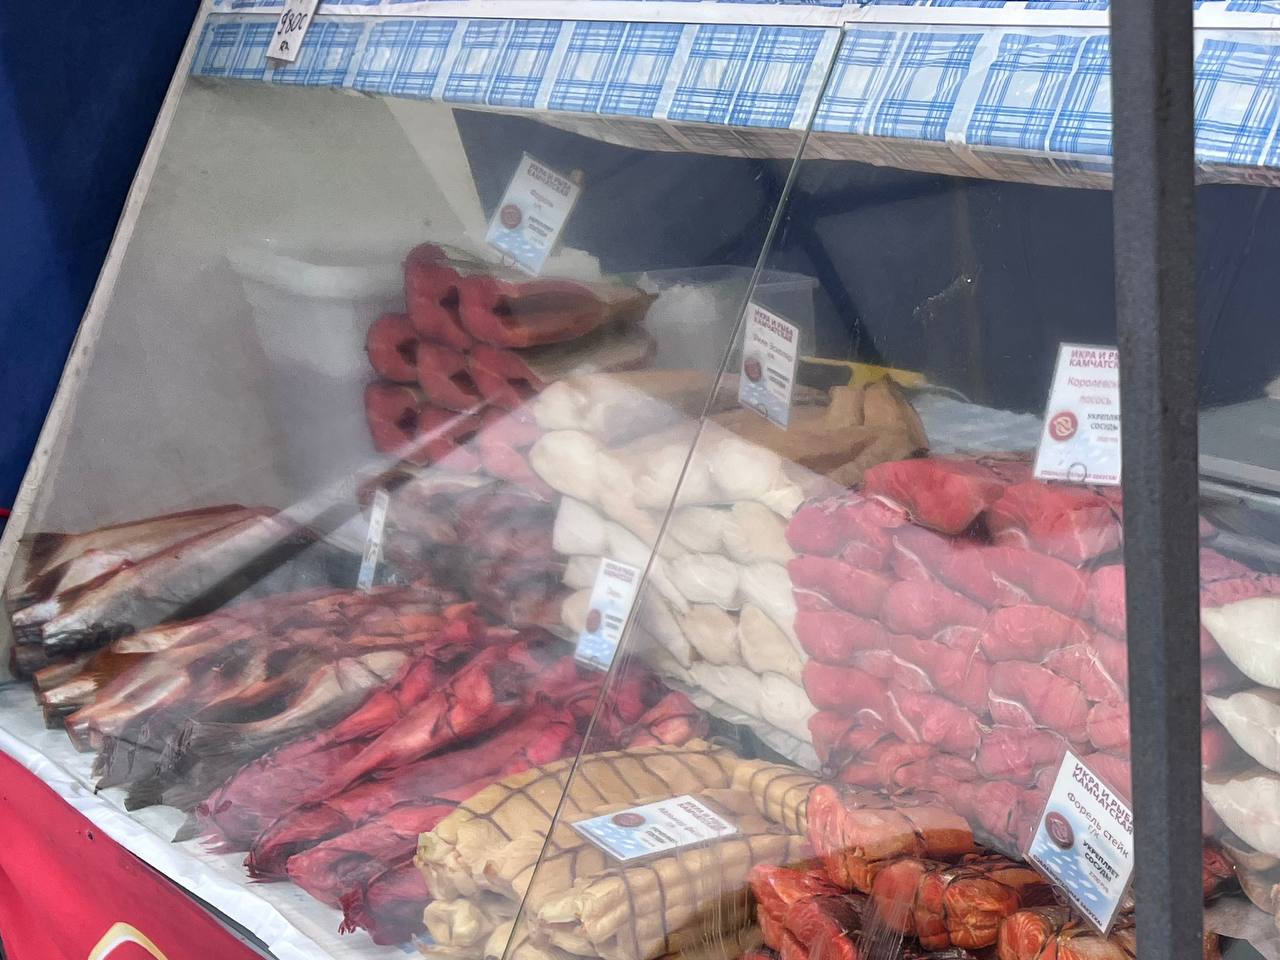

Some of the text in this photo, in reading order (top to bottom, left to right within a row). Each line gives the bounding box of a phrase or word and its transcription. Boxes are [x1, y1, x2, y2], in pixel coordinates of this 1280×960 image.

[1068, 377, 1119, 388] Королевск
[1069, 359, 1119, 369] КАМЧАТСК
[1074, 762, 1100, 792] ИКРА
[1101, 789, 1109, 801] И
[1071, 769, 1133, 836] КАМЧАТСКАЯ
[1065, 789, 1131, 861] Форель стейк
[1082, 839, 1119, 881] УКРЕПЛЯЕТ
[1084, 851, 1111, 884] СОСУДЫ
